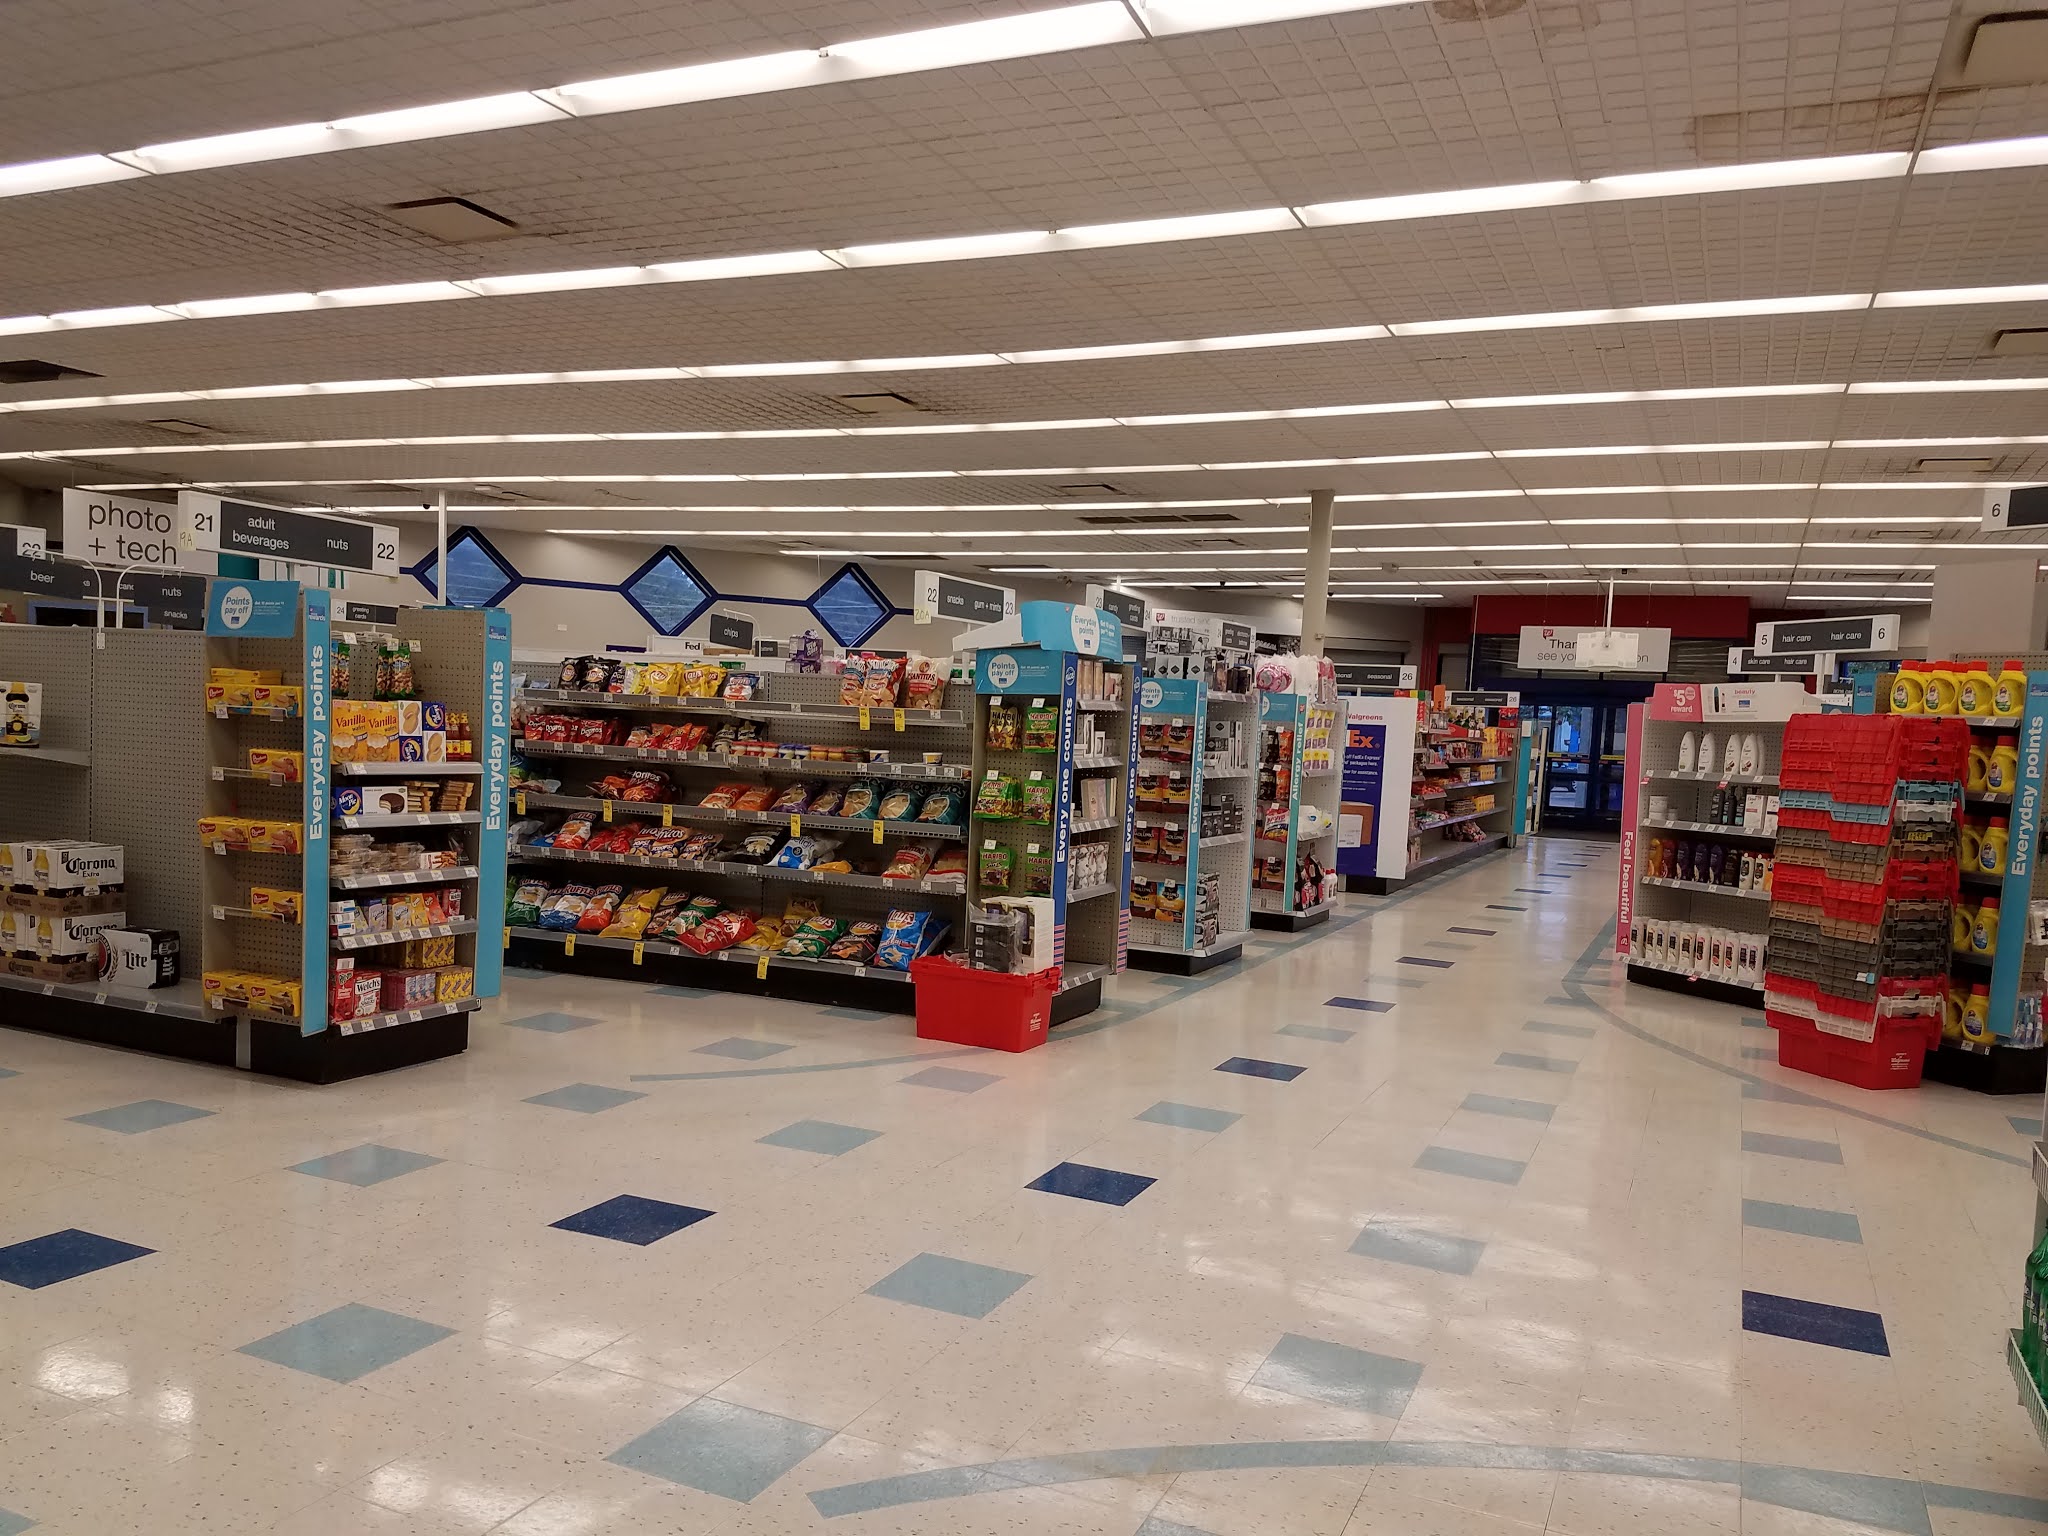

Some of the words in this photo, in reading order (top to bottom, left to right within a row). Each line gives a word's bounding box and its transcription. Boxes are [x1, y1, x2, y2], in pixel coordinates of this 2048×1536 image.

[88, 500, 171, 533] photo
[1991, 503, 2001, 517] 6
[194, 513, 213, 533] 21
[247, 516, 276, 531] adult
[232, 530, 290, 550] beverages
[326, 538, 349, 551] nuts
[116, 534, 177, 565] tech
[376, 542, 396, 561] 22
[30, 570, 55, 584] beer
[162, 587, 182, 598] nuts
[927, 588, 938, 604] 22
[225, 596, 250, 606] Points
[946, 594, 965, 606] snacks
[973, 600, 986, 611] gum
[991, 602, 1004, 613] mints
[1095, 597, 1103, 609] 23
[163, 610, 188, 621] snacks
[224, 606, 237, 616] pay
[238, 606, 249, 615] off
[336, 606, 345, 616] 24
[1005, 602, 1015, 616] 23
[1074, 614, 1097, 629] Everyday
[1144, 613, 1151, 626] 24
[1171, 617, 1196, 629] trusted
[723, 627, 739, 639] chips
[1078, 626, 1095, 640] points
[1781, 635, 1796, 644] hair
[1796, 635, 1812, 643] care
[1830, 631, 1845, 641] hair
[1846, 631, 1862, 641] care
[1878, 627, 1886, 640] 6
[685, 641, 701, 651] Fed
[1761, 635, 1768, 646] 5
[1537, 653, 1557, 661] see
[1733, 657, 1738, 665] 4
[991, 661, 1016, 672] Points
[908, 673, 936, 682] SANTITAS
[991, 671, 1004, 681] pay
[1005, 670, 1015, 679] off
[1401, 672, 1413, 681] 26
[309, 644, 326, 722] points
[489, 660, 507, 728] points
[1673, 689, 1686, 706] $5
[1734, 688, 1755, 696] beauty
[336, 713, 366, 729] Vanilla
[368, 714, 397, 730] Vanilla
[545, 724, 566, 735] Doritos
[581, 727, 603, 737] Doritos
[1063, 697, 1074, 763] counts
[1196, 716, 1205, 762] points
[486, 733, 507, 831] Everyday
[1124, 803, 1133, 853] Every
[1131, 703, 1139, 763] counts
[1292, 758, 1302, 801] Allergy
[309, 733, 326, 840] Everyday
[982, 782, 1006, 790] HARIBO
[1061, 767, 1072, 804] one
[1191, 766, 1203, 834] Everyday
[2010, 784, 2038, 876] Everyday
[2024, 715, 2044, 779] points
[655, 828, 686, 840] Fritos
[1056, 808, 1069, 863] Every
[1623, 831, 1634, 860] Feel
[66, 857, 118, 875] Corona
[1619, 864, 1632, 925] beautiful
[889, 910, 915, 923] Lay's
[124, 950, 148, 975] Lite
[357, 979, 381, 993] Welch's
